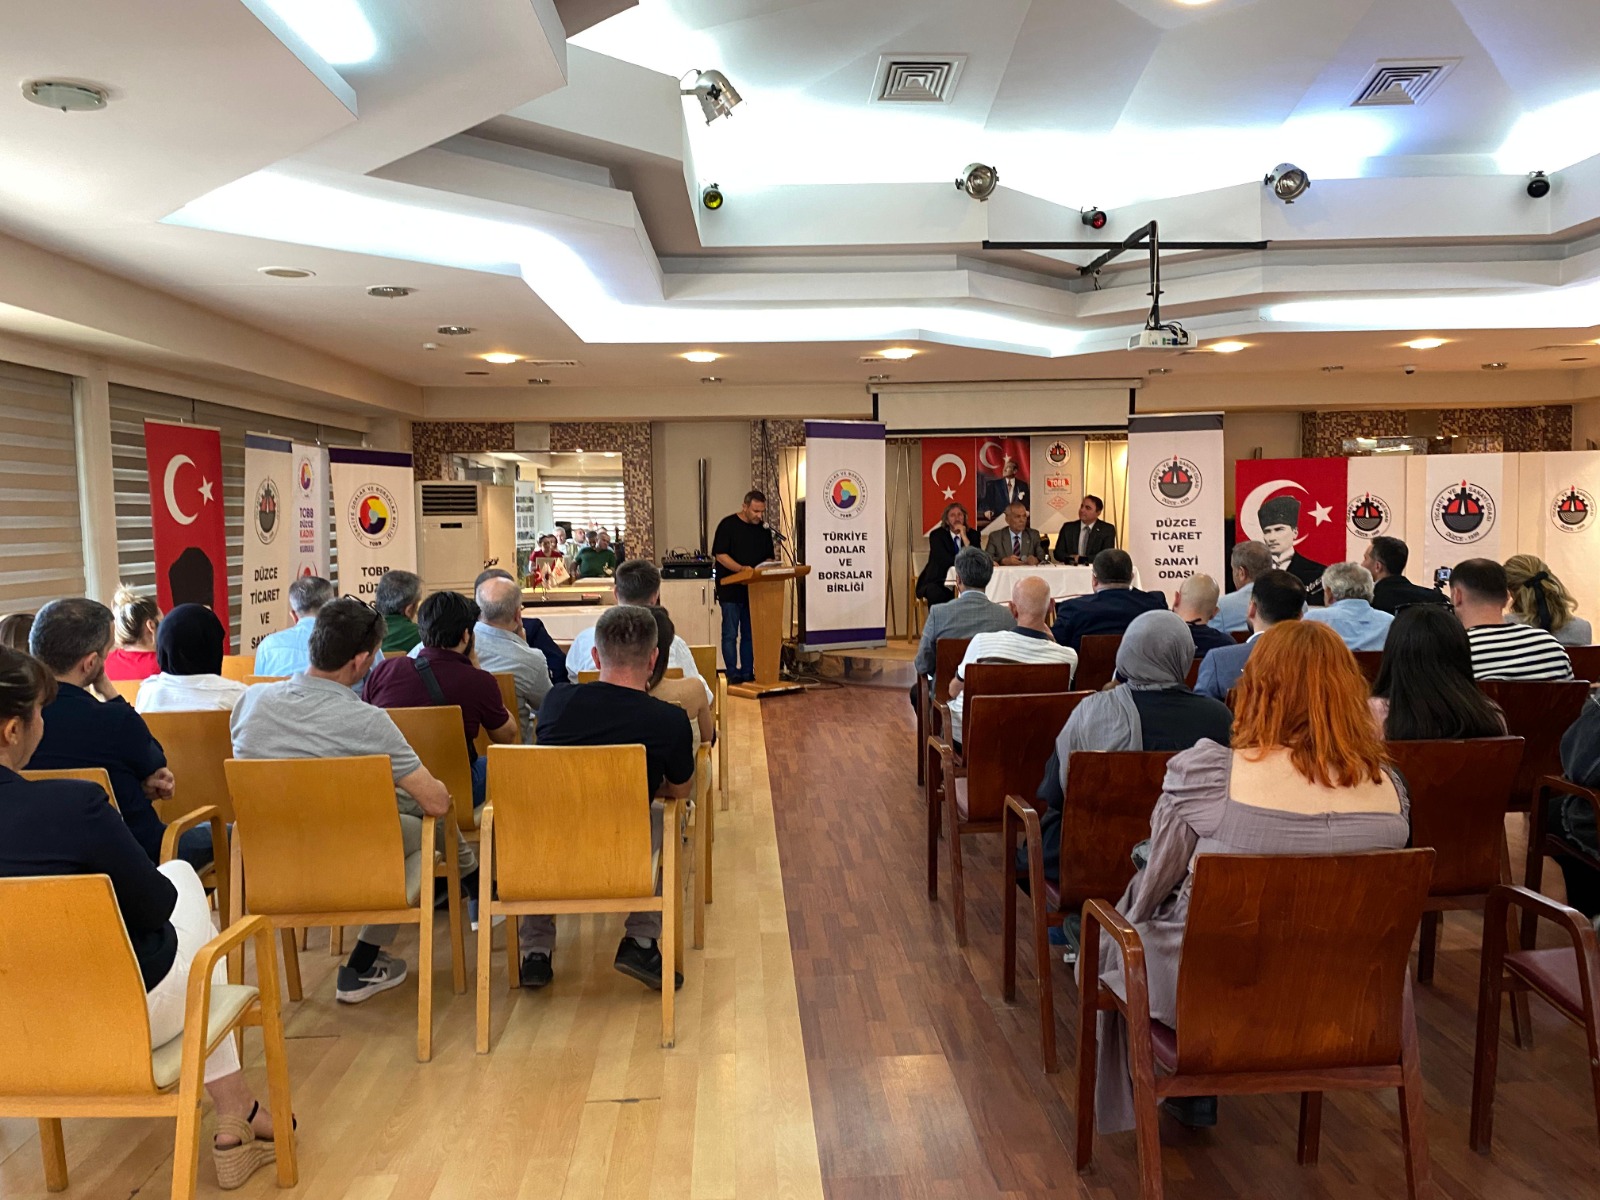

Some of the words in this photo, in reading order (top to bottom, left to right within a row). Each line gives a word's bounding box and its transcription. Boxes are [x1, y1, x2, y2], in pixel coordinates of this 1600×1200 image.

[1155, 517, 1197, 528] DÜZCE
[823, 531, 868, 541] TÜRKİYE
[1151, 531, 1202, 540] TİCARET
[825, 544, 866, 554] ODALAR
[1168, 544, 1184, 553] VE
[838, 558, 853, 567] VE
[1154, 554, 1199, 566] SANAYİ
[254, 566, 278, 581] DÜZCE
[818, 570, 872, 580] BORSALAR
[826, 581, 864, 593] BİRLİĞİ
[250, 588, 280, 605] TİCARET
[260, 611, 270, 625] VE
